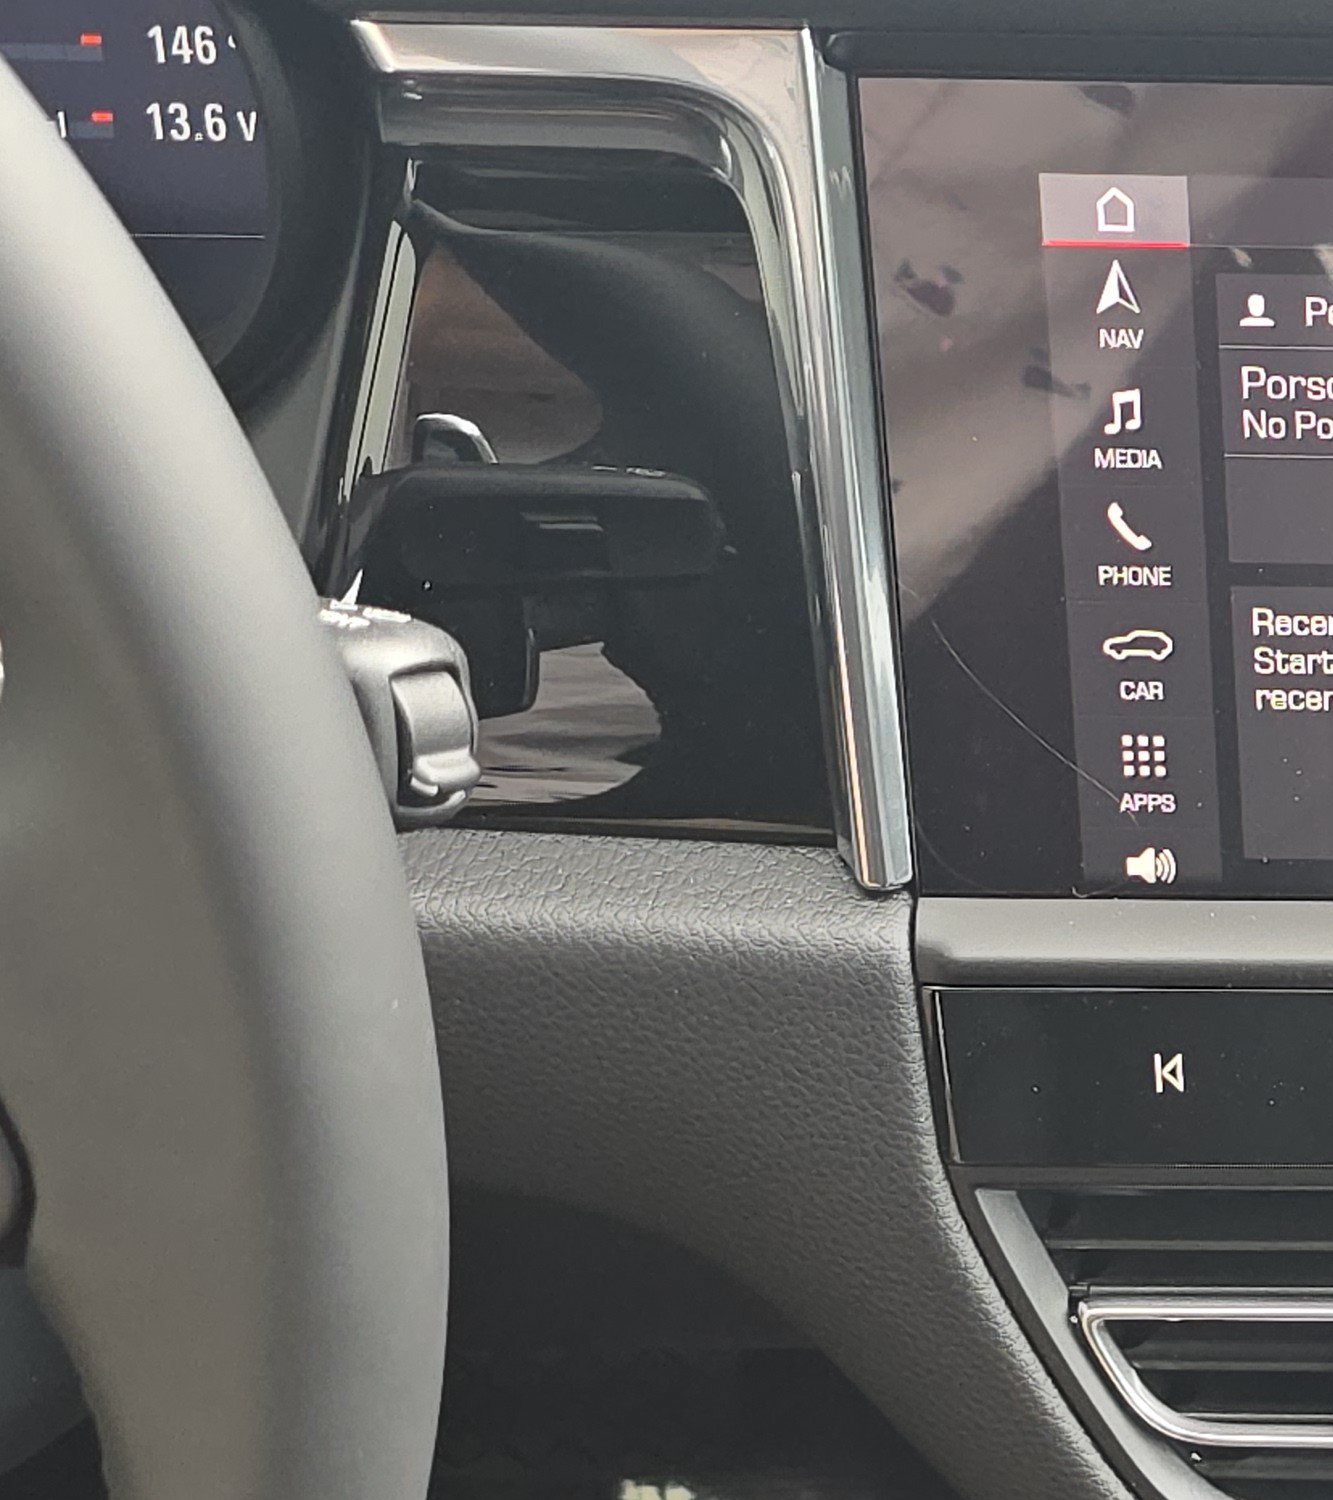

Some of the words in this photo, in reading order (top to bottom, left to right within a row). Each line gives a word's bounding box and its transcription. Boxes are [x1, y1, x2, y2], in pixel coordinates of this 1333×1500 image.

[147, 25, 217, 65] 146
[146, 102, 227, 142] 13.6
[1099, 328, 1144, 350] NAV
[1242, 409, 1286, 439] No
[1094, 447, 1163, 470] MEDIA
[1097, 565, 1172, 586] PHONE
[1119, 681, 1164, 701] CAR
[1119, 792, 1176, 814] APPS
